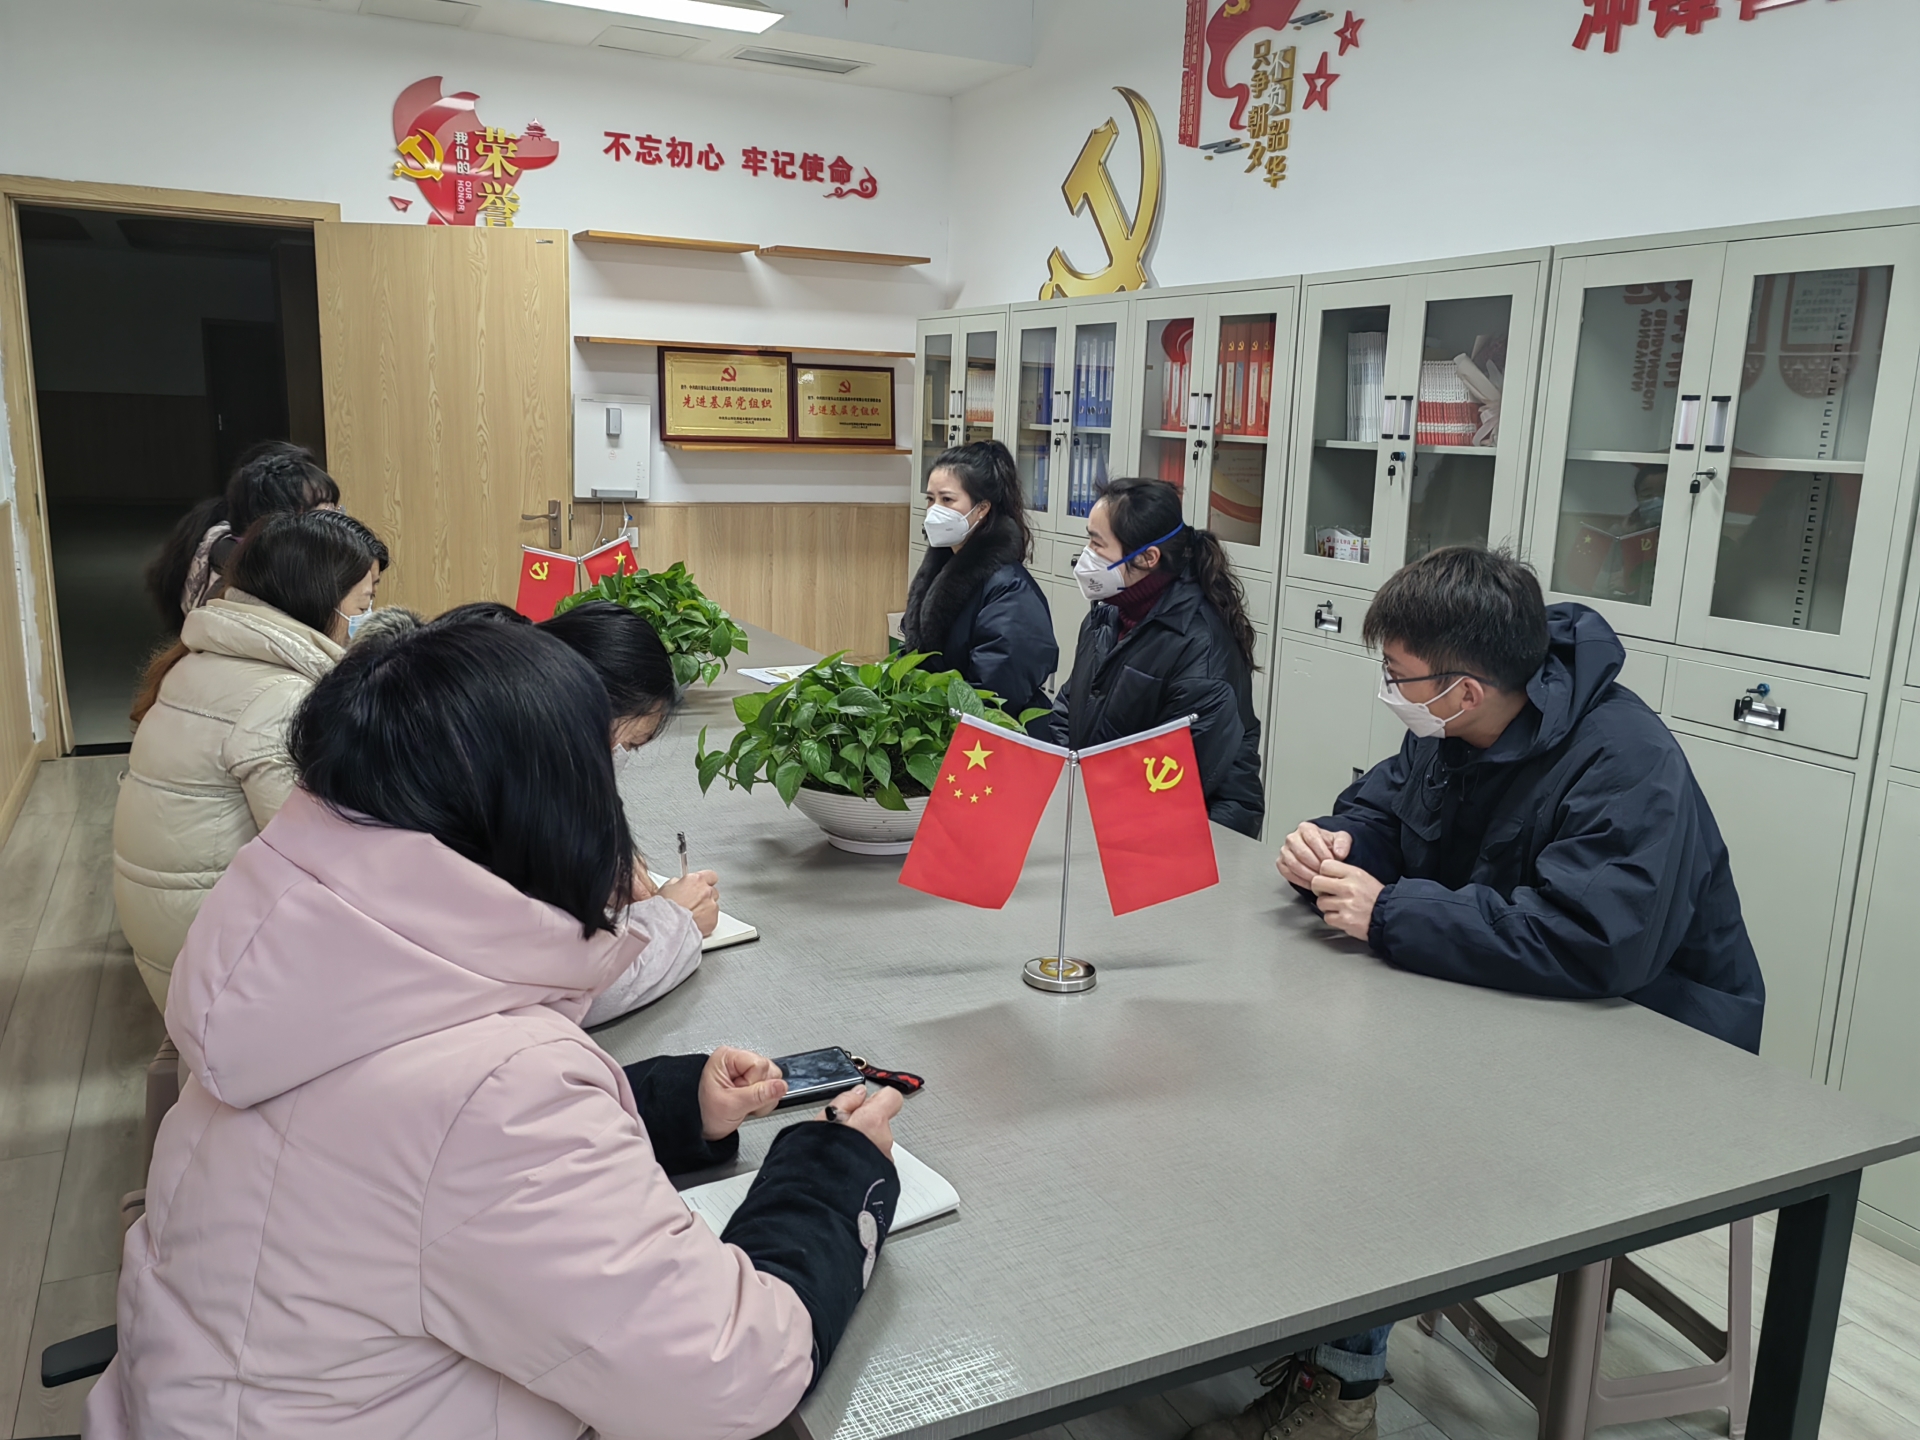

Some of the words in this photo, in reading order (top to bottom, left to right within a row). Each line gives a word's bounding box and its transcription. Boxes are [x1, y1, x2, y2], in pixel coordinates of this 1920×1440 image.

[1244, 39, 1272, 173] 只争朝夕
[1263, 46, 1296, 189] 不负韶华
[454, 131, 470, 175] 我们的
[475, 126, 520, 226] 荣誉
[603, 130, 726, 171] 不忘初心
[741, 145, 854, 185] 牢记使命
[457, 180, 465, 211] HONOR
[682, 393, 773, 411] 先进基层党组织
[808, 403, 880, 418] 先进基层党组织
